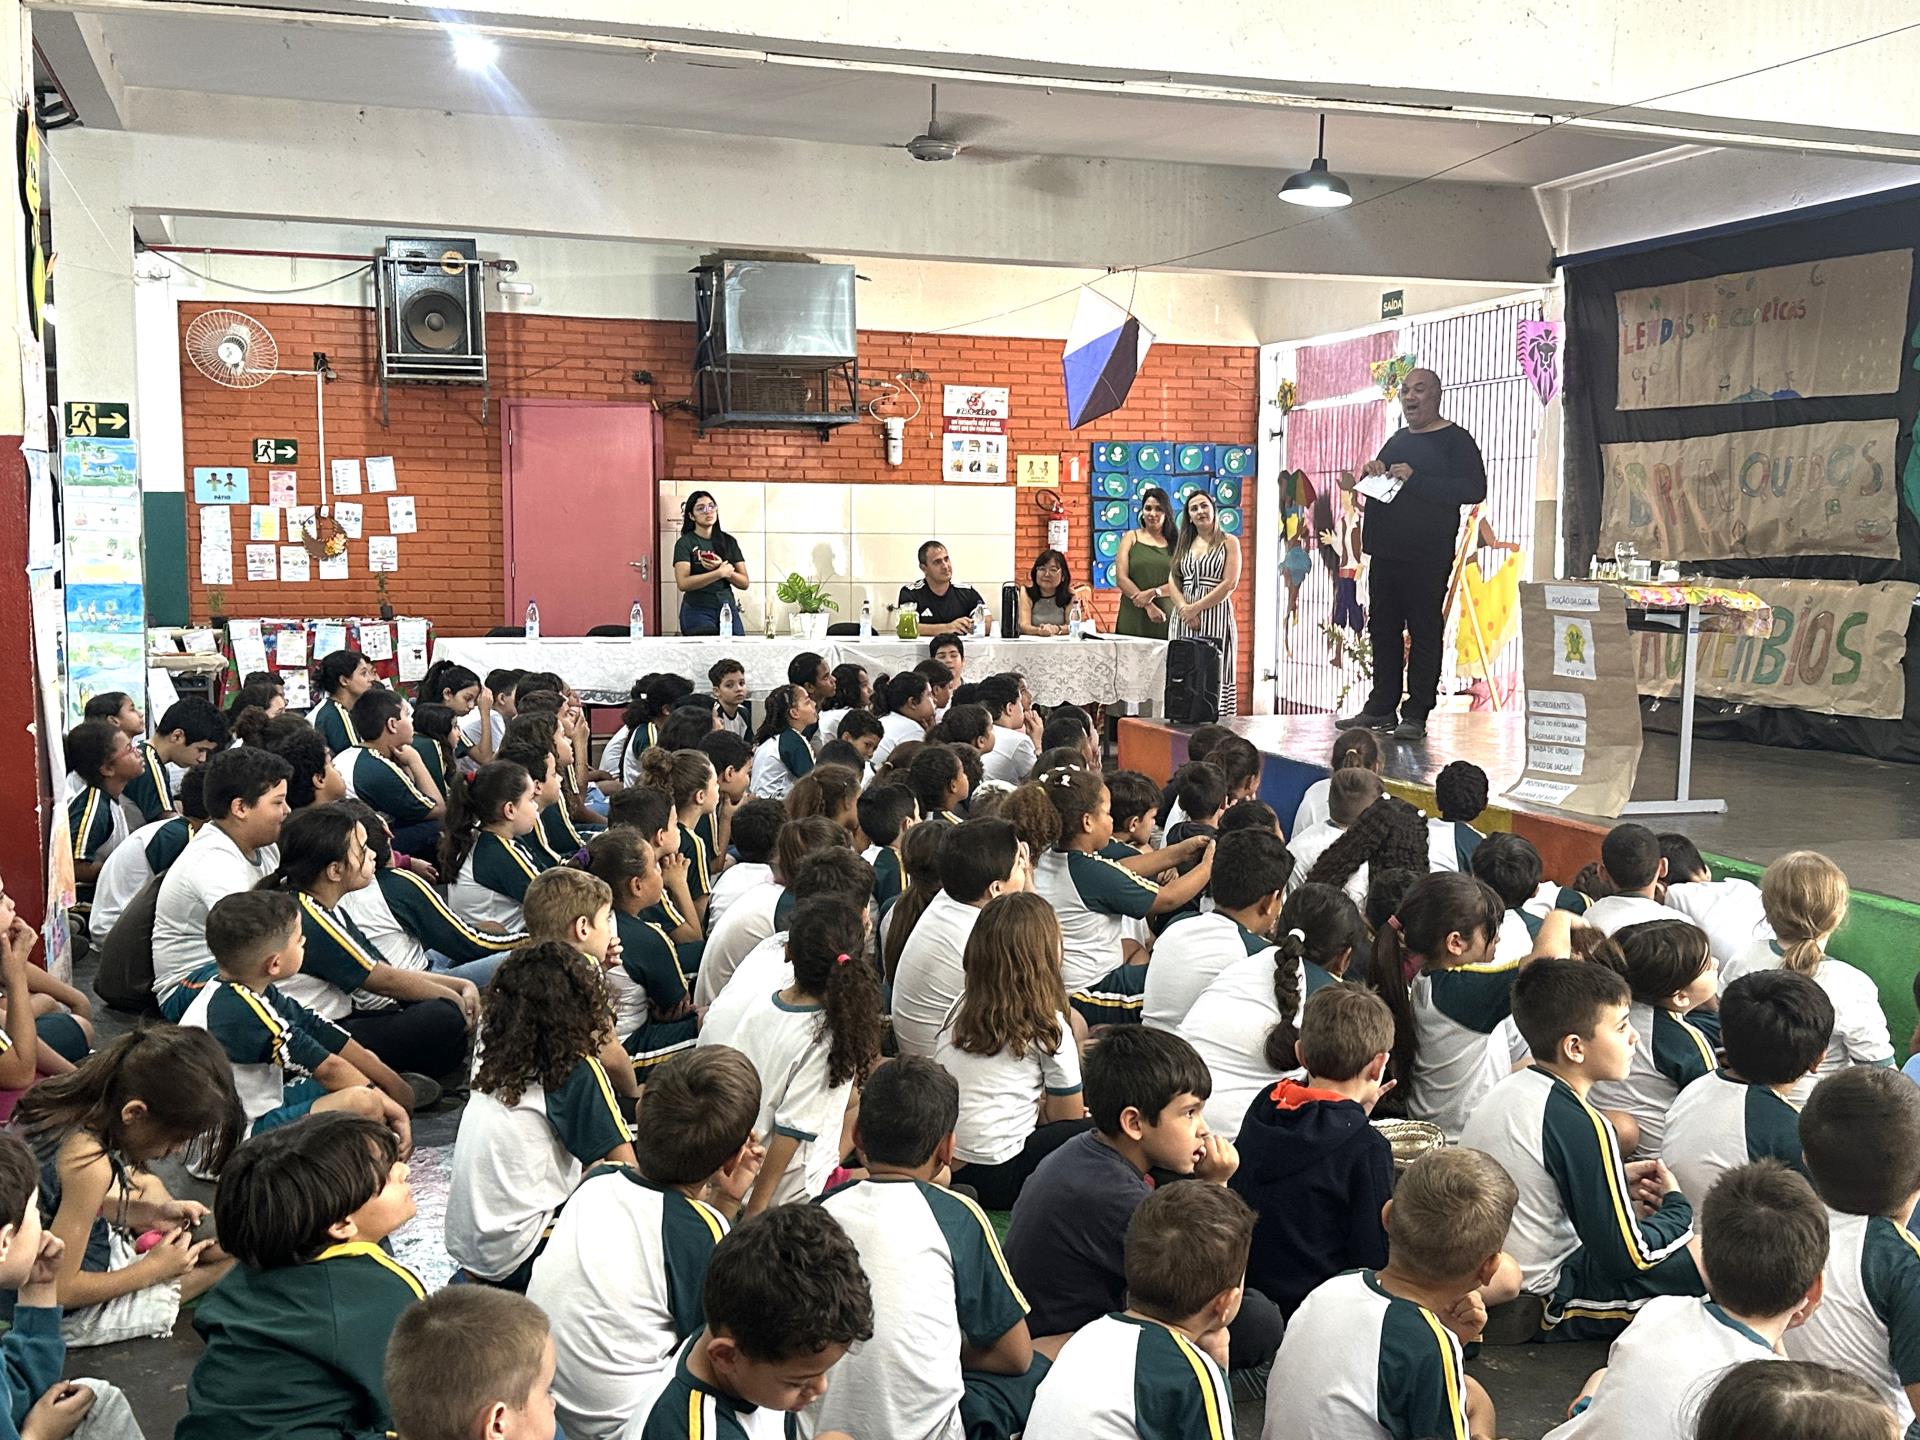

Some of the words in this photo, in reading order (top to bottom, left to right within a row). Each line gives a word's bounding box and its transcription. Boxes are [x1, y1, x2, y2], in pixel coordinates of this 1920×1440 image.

[1383, 298, 1402, 312] SAÍDA
[1622, 314, 1695, 355] LENDAS
[1551, 595, 1569, 605] POÇÃO
[1577, 598, 1592, 606] CUCA
[1566, 668, 1585, 676] CUCA
[1547, 746, 1554, 754] DE
[1532, 760, 1546, 769] SUCO
